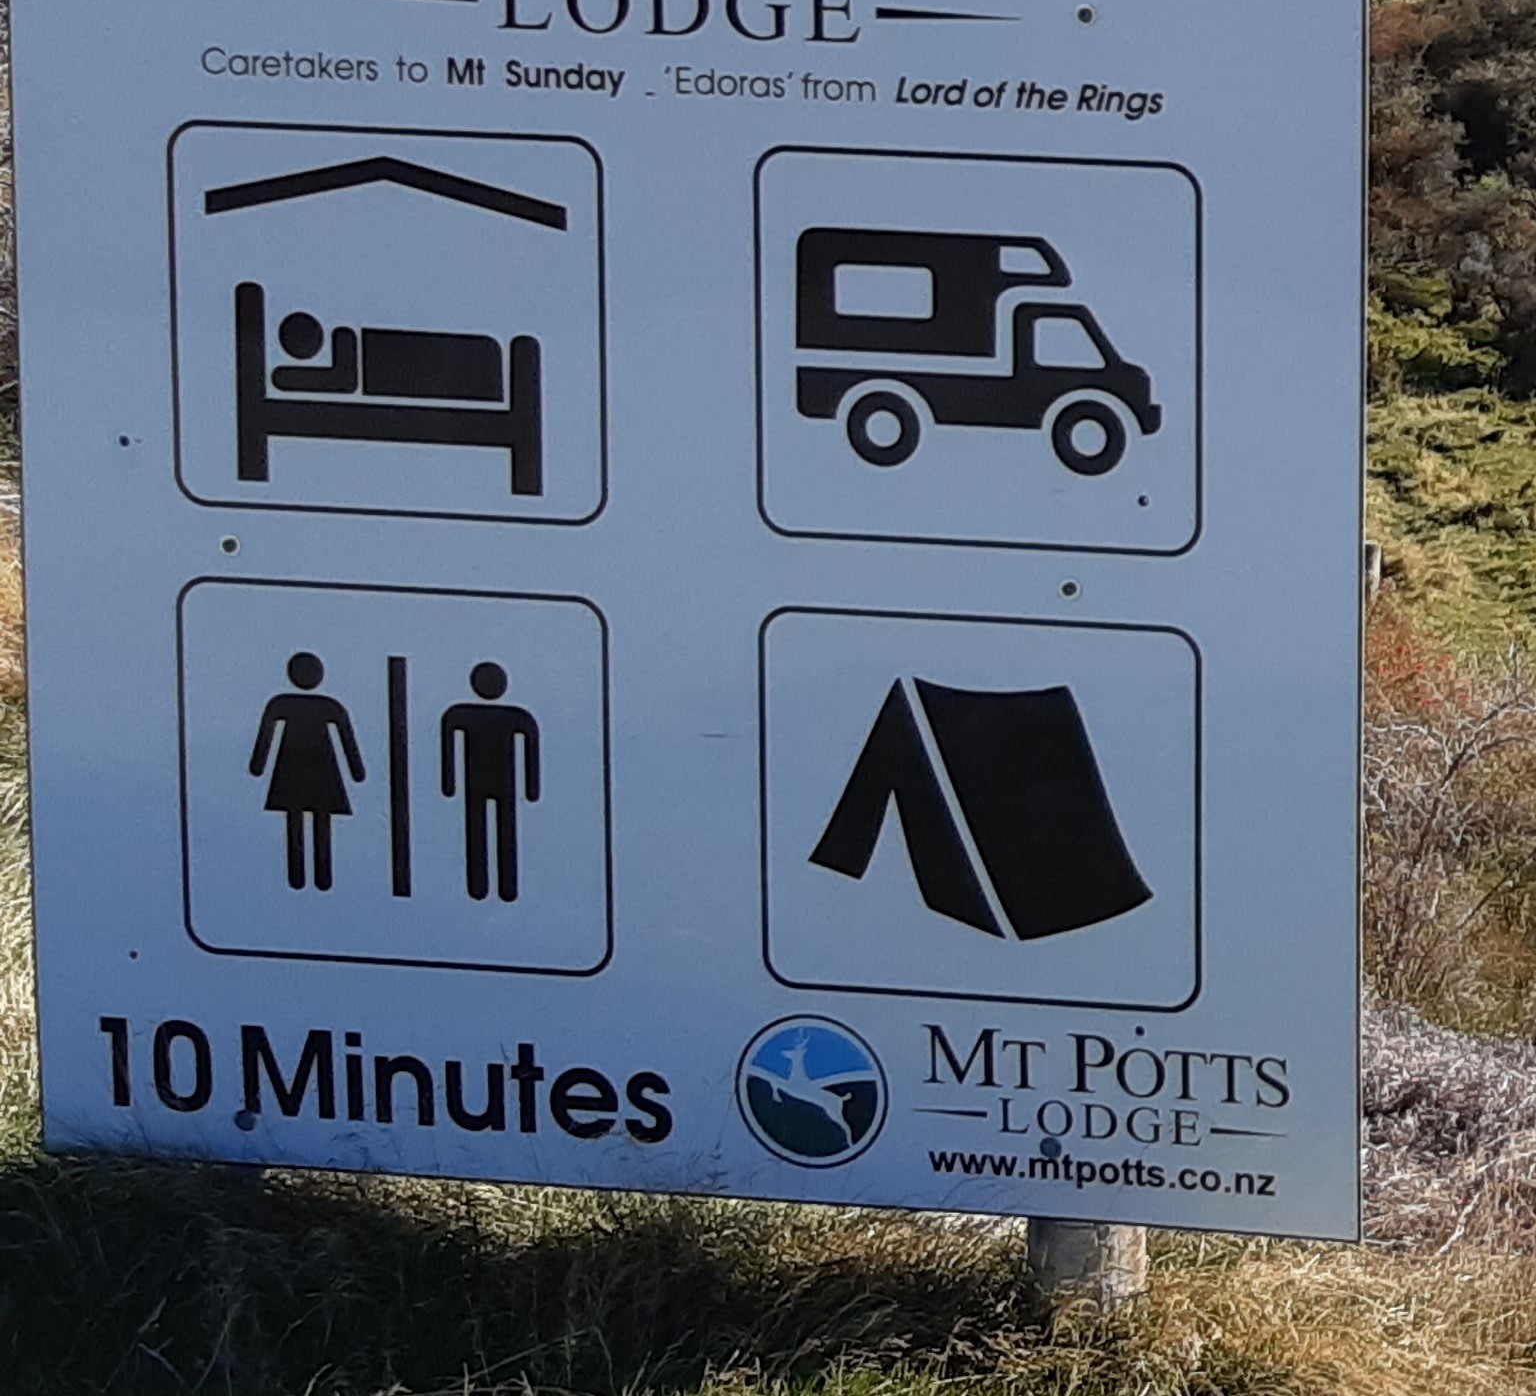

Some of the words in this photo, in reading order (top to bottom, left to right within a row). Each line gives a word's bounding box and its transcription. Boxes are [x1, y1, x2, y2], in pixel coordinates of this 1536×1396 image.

[200, 46, 379, 82] Caretakers
[395, 55, 429, 84] to
[447, 57, 486, 86] Mt
[505, 59, 626, 98] Sunday
[800, 72, 876, 102] from
[895, 76, 968, 106] Lord
[973, 81, 1008, 108] of
[1015, 81, 1069, 111] the
[1076, 83, 1164, 121] Rings
[99, 1016, 213, 1113] 10
[240, 1024, 673, 1144] Minutes
[1067, 1032, 1291, 1108] POTTS
[998, 1097, 1202, 1147] LODGE
[928, 1150, 1276, 1196] www.mtpotts.co.nz
